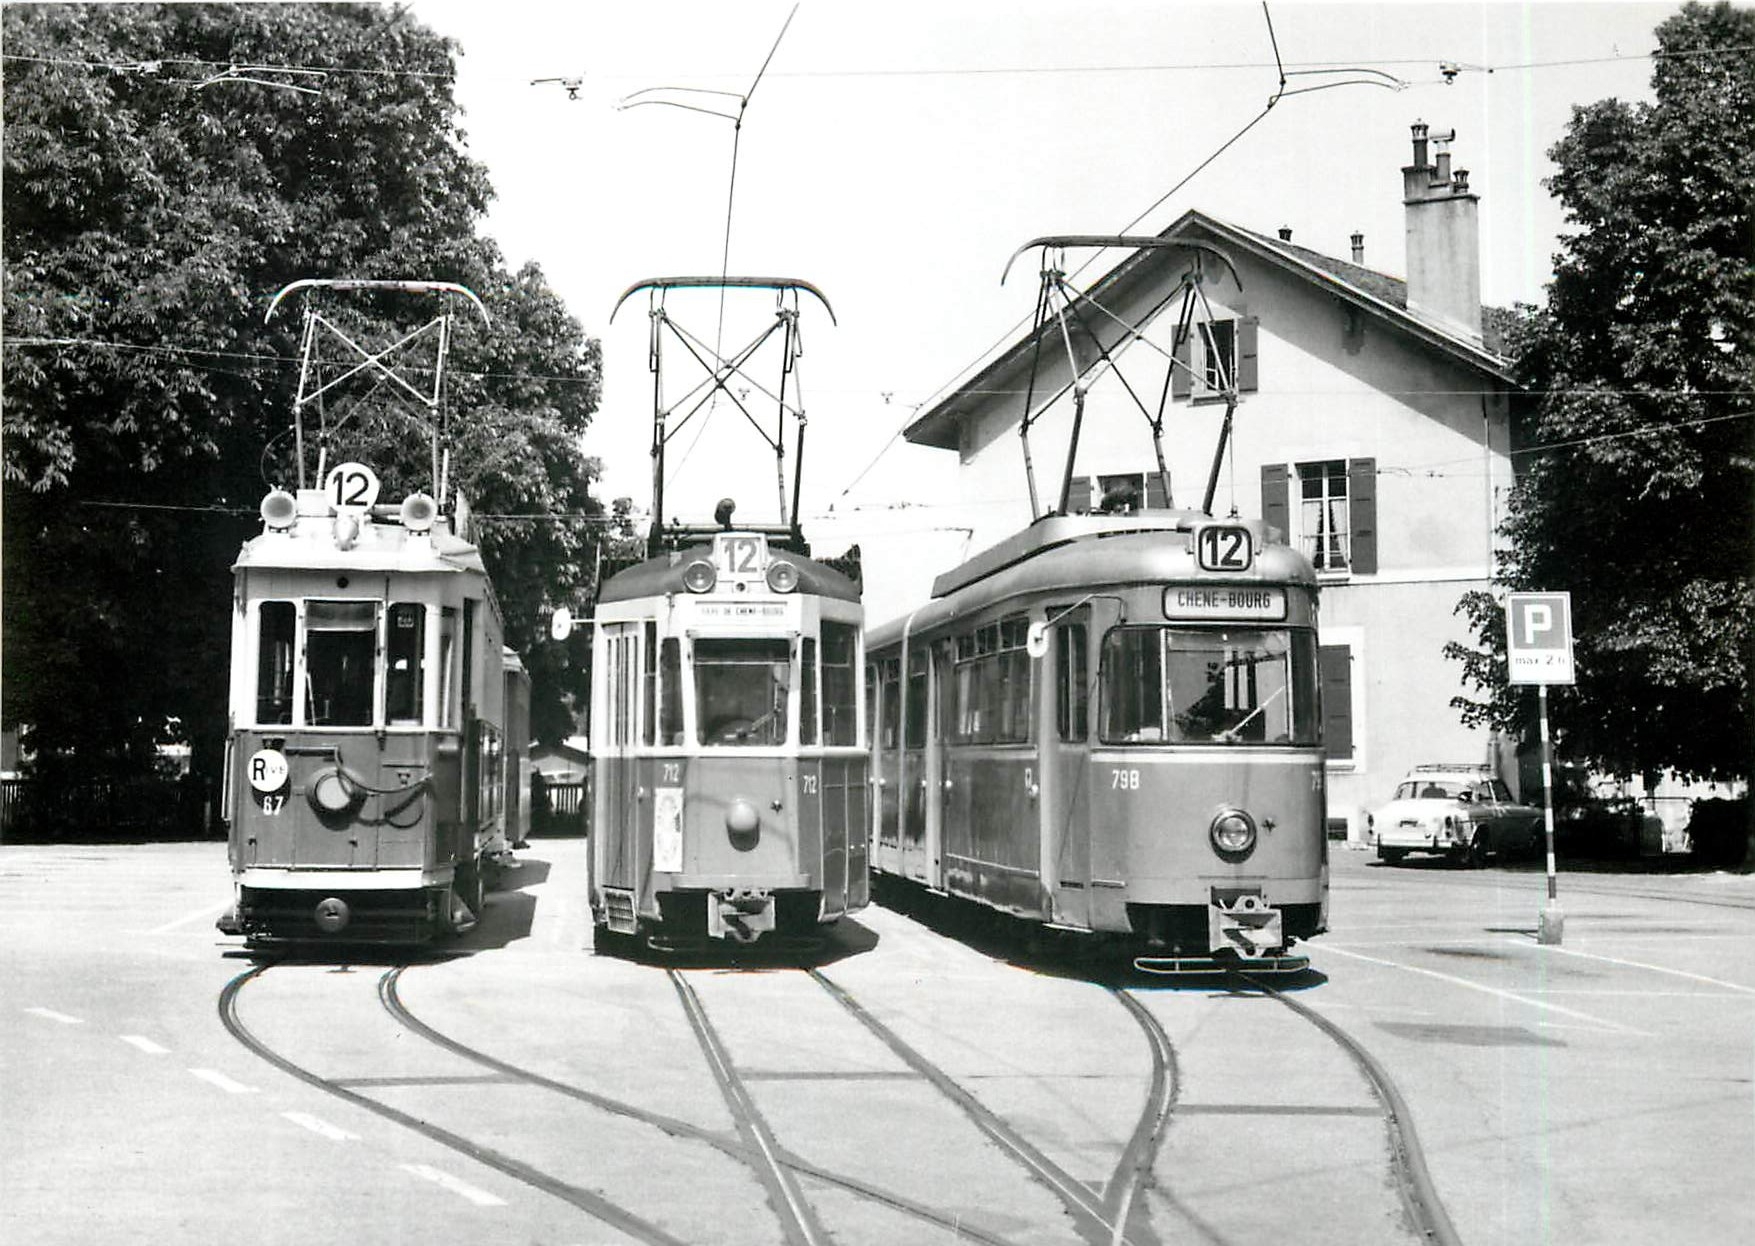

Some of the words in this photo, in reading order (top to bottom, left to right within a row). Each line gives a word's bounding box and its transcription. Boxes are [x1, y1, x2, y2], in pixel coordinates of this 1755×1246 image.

[333, 471, 369, 506] 12
[724, 539, 758, 574] 12
[1205, 527, 1243, 566] 12
[1524, 604, 1553, 645] P
[1545, 654, 1555, 666] 2
[1111, 769, 1140, 790] 798
